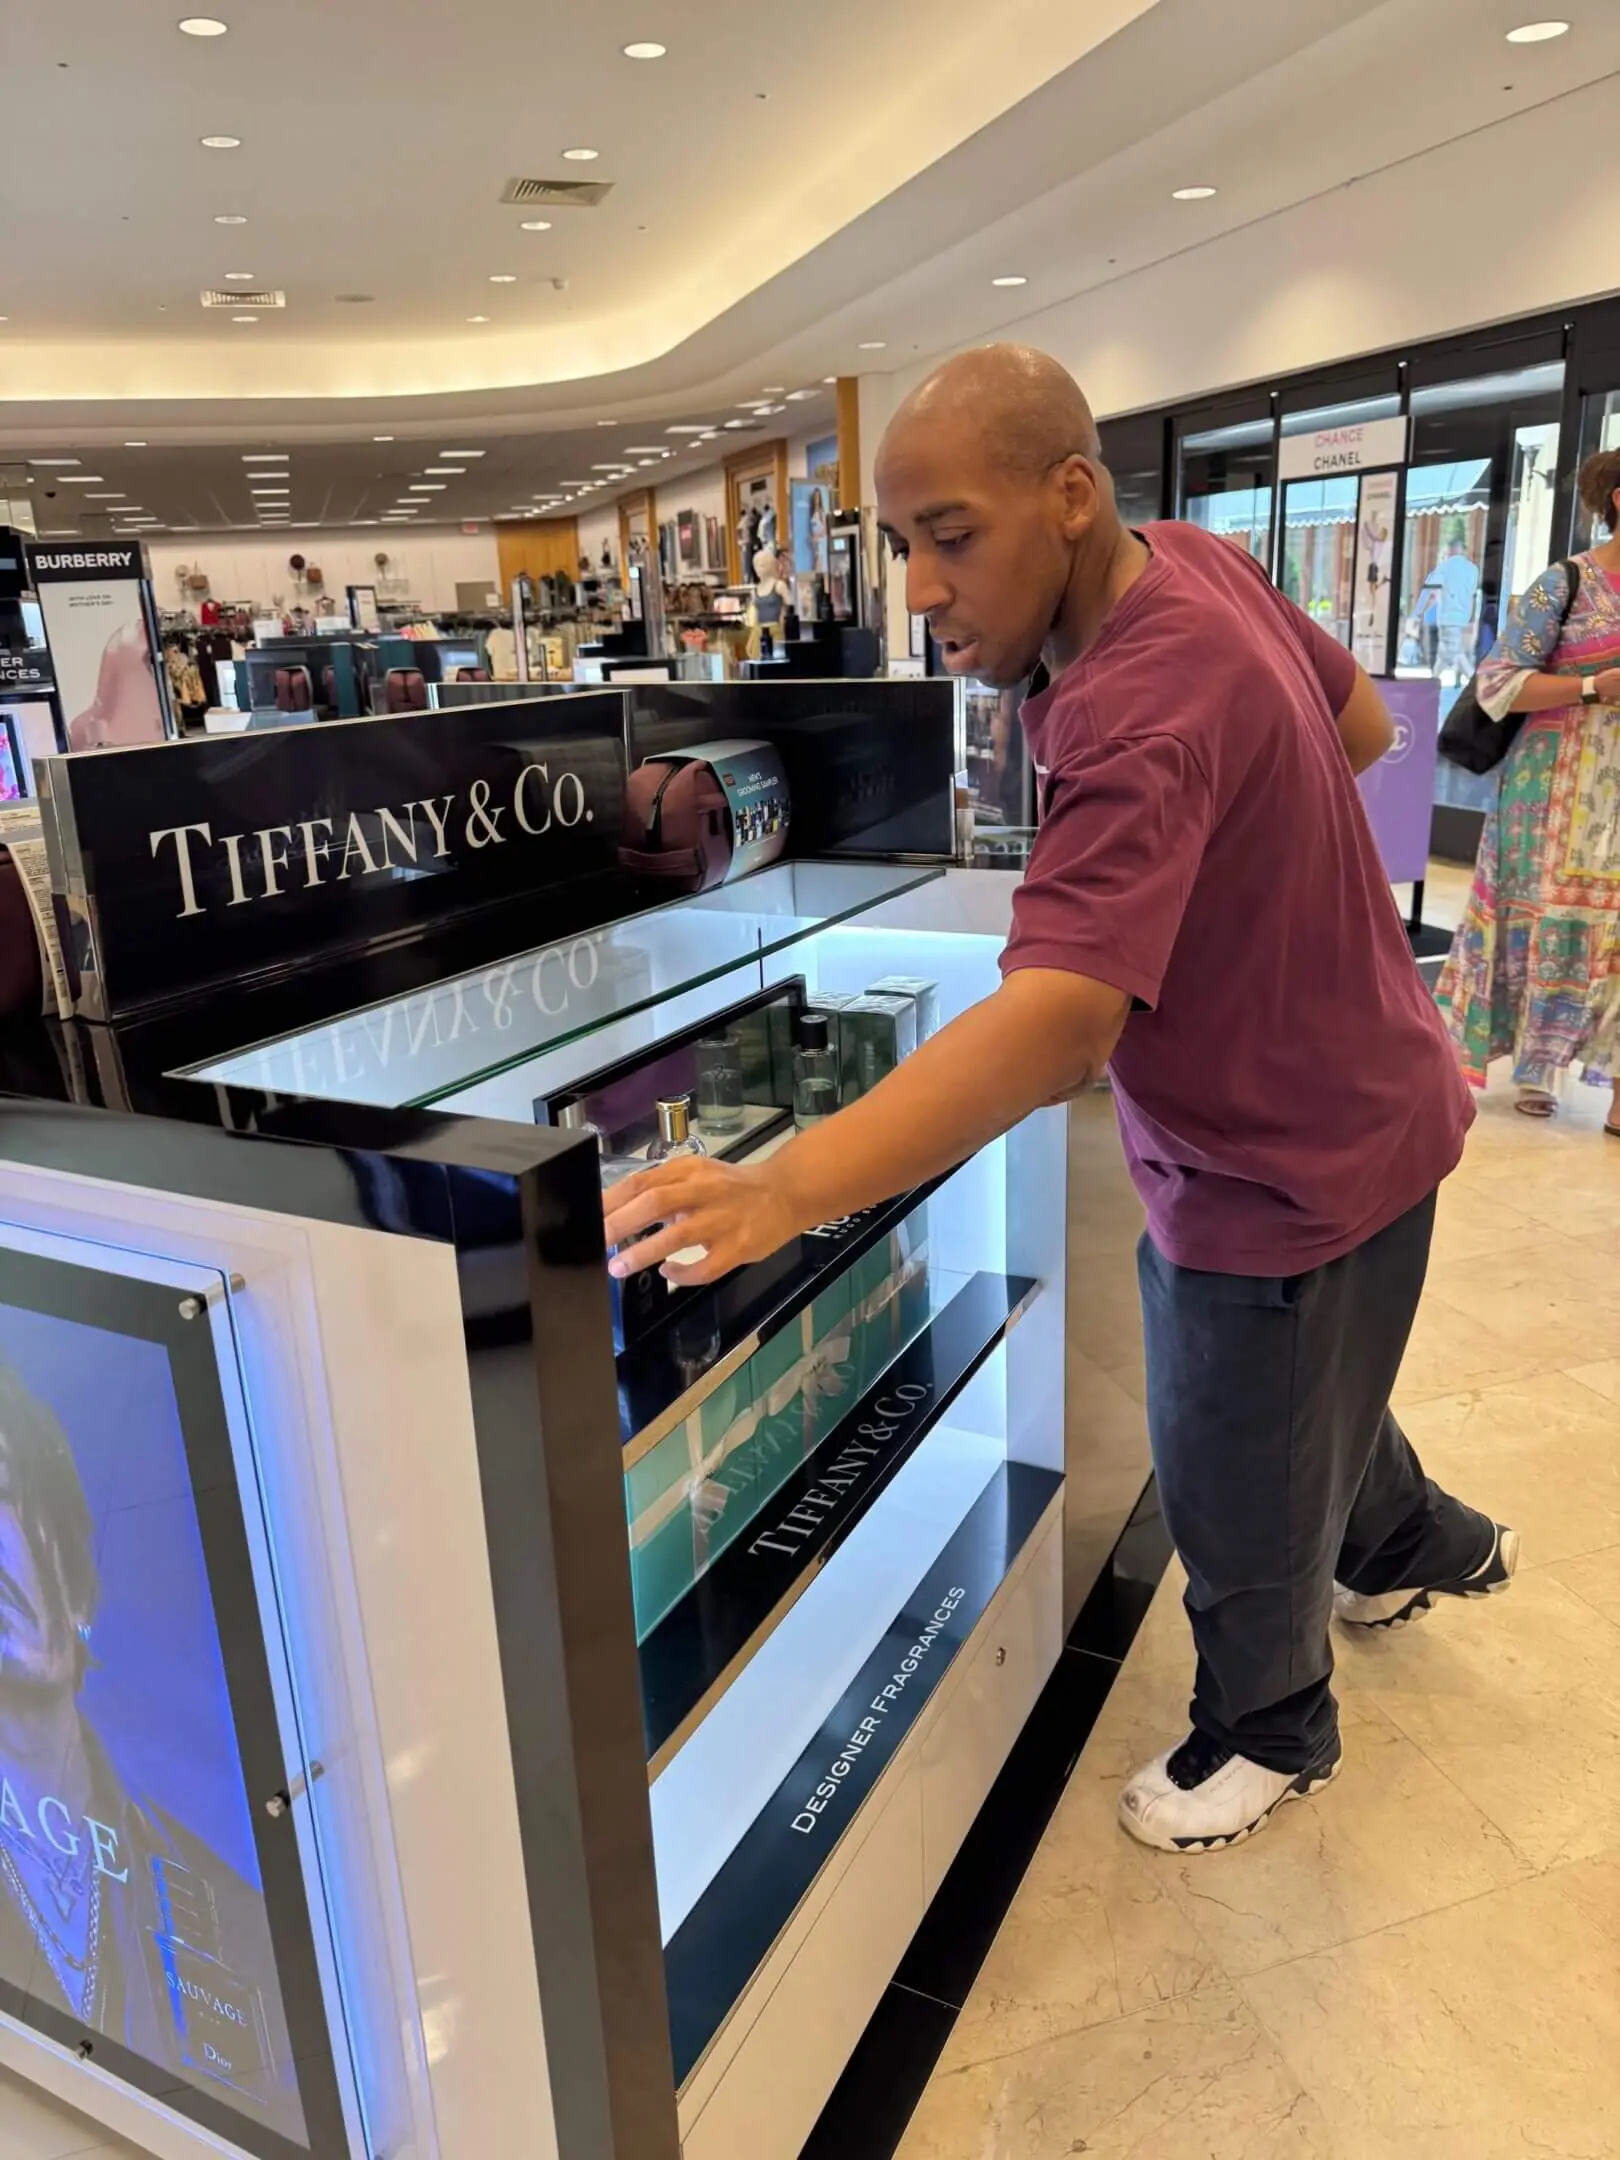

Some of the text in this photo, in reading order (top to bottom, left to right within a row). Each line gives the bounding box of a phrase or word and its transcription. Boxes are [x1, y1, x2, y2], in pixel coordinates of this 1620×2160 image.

[1314, 451, 1361, 470] CHANEL
[1315, 428, 1364, 448] CHANCE
[35, 552, 132, 569] BURBERRY
[149, 761, 595, 918] TIFFANY & CO.
[747, 1438, 880, 1557] TIFFANY
[874, 1383, 933, 1417] CO.
[790, 1586, 965, 1834] DESIGNER FRAGRANCES
[0, 1777, 128, 1883] AGE
[166, 1971, 248, 2027] SAUVAGE
[202, 2042, 232, 2070] Dior
